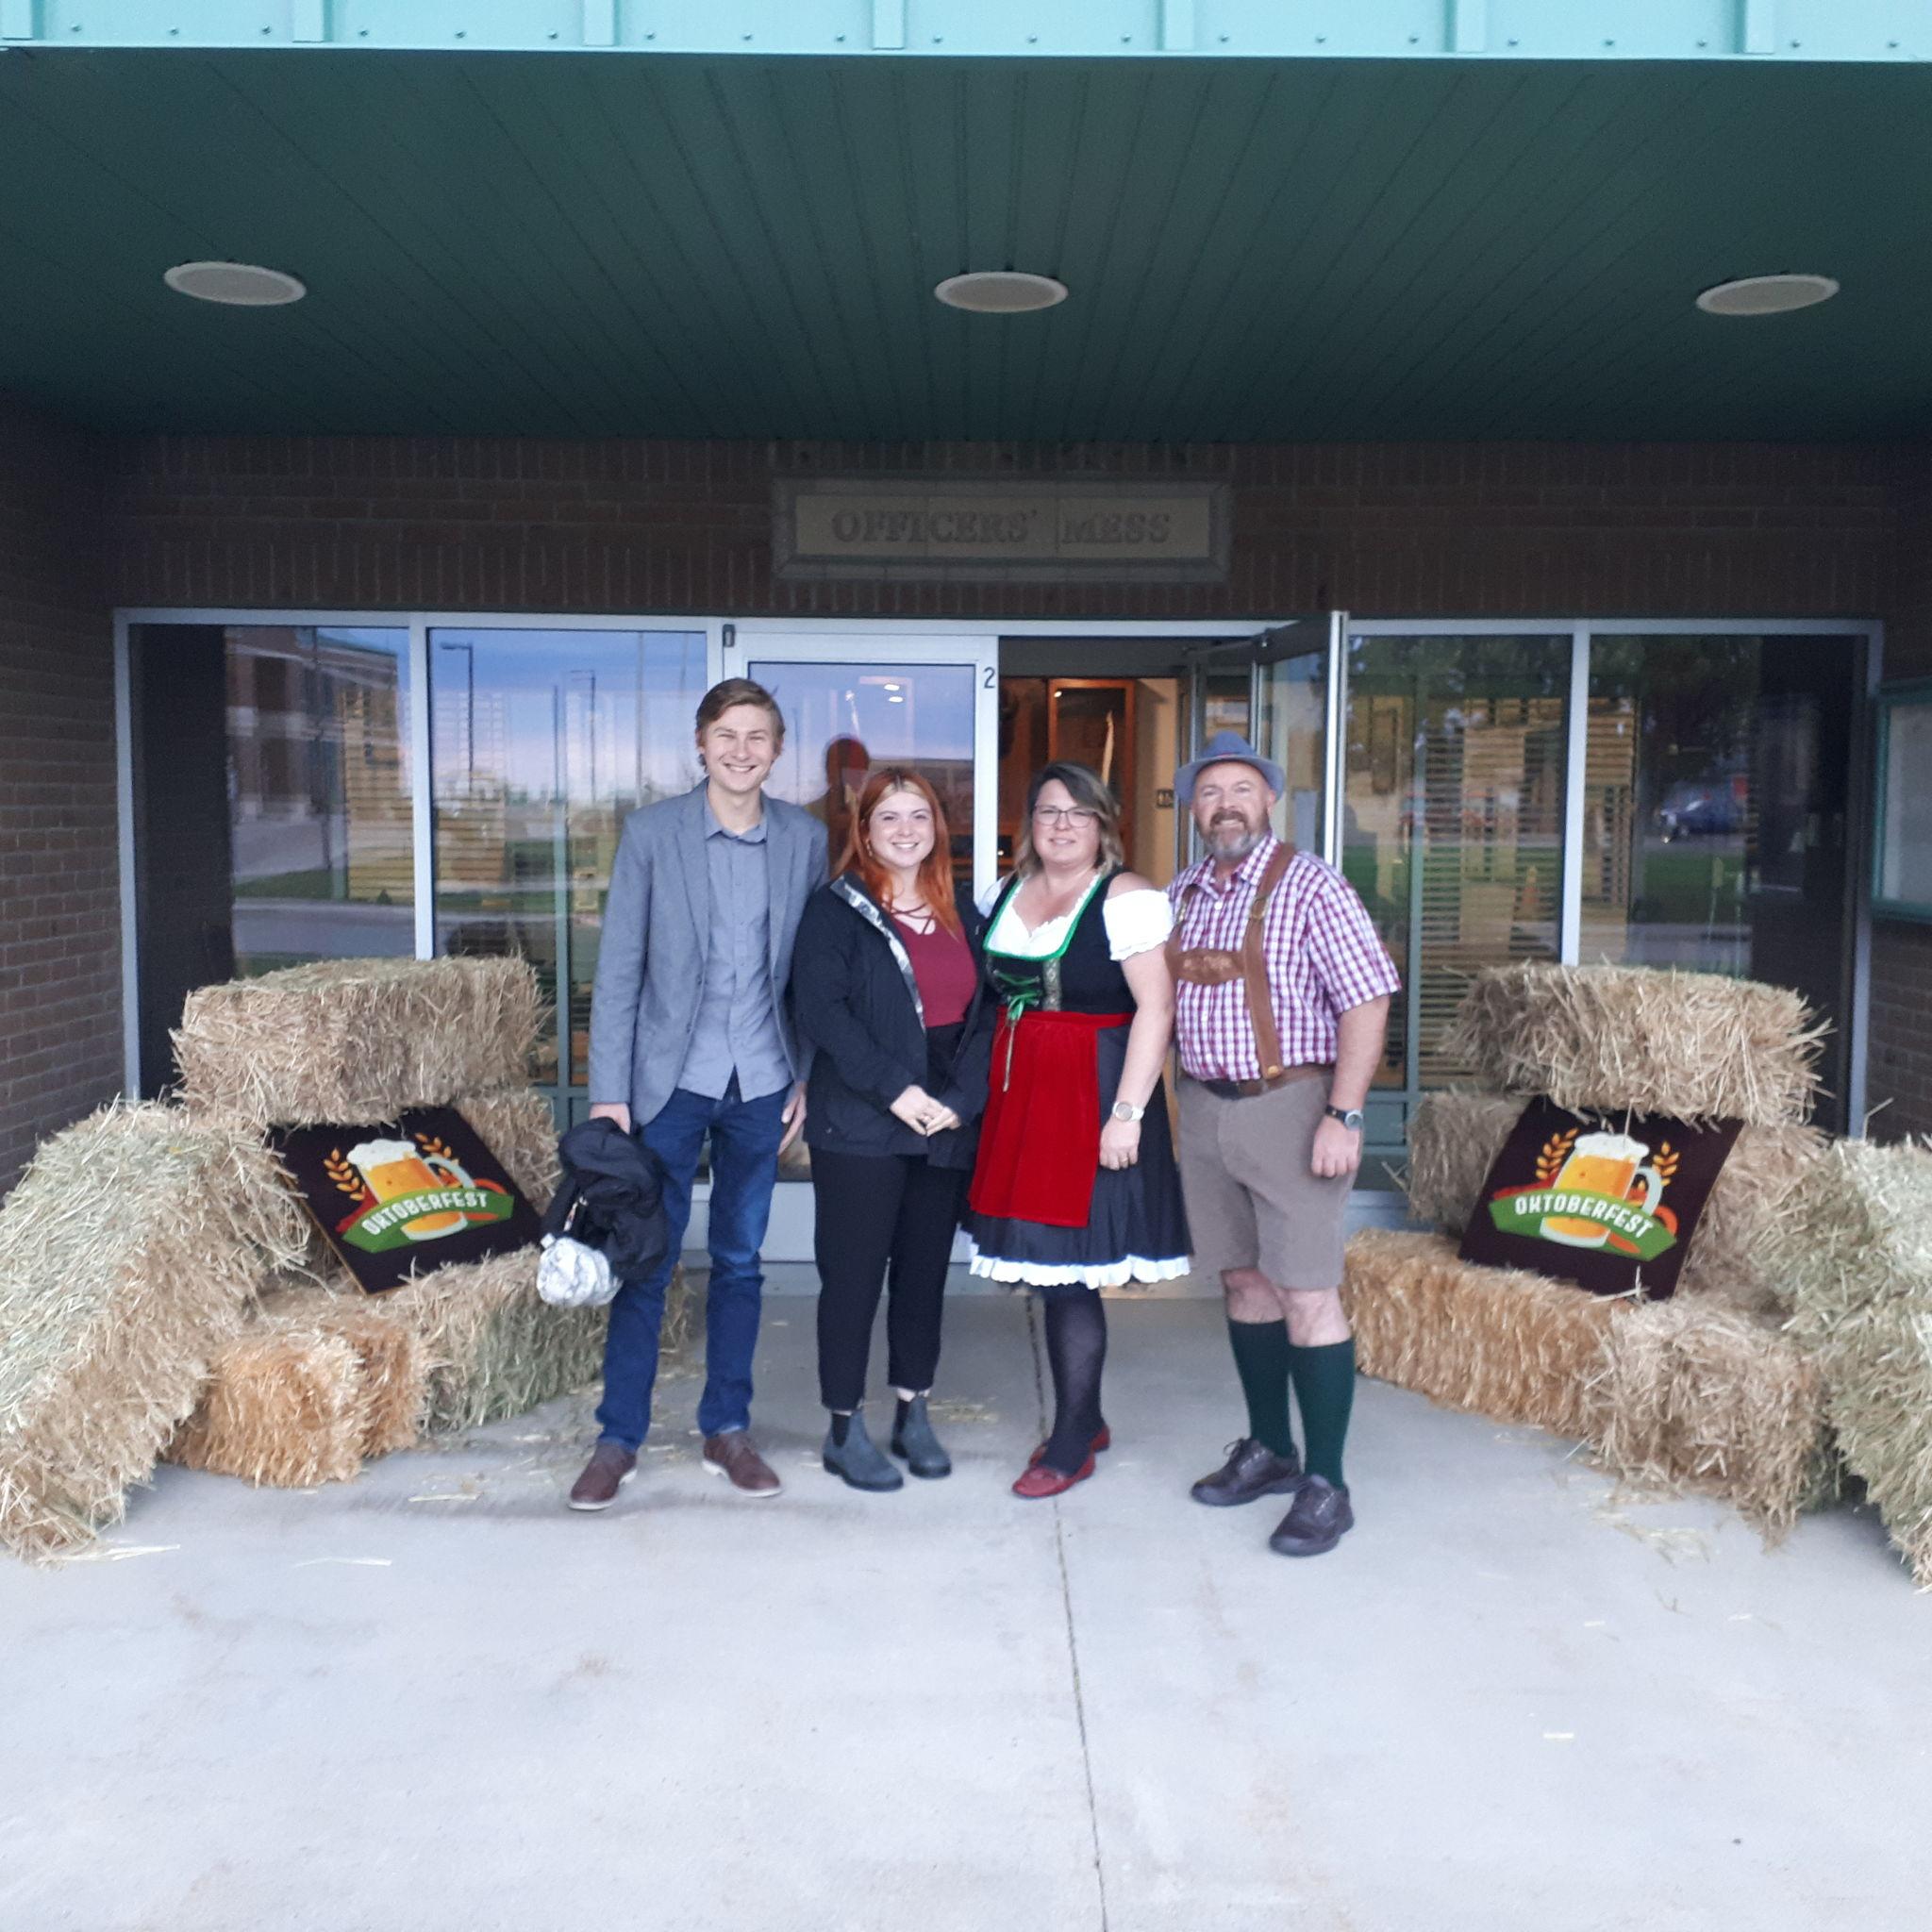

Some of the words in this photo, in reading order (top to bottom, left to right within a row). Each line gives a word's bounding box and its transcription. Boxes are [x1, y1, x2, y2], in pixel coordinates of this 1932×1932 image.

[831, 509, 1037, 544] OFFICERS'
[1061, 512, 1171, 544] MESS
[983, 667, 995, 689] 2
[361, 1191, 488, 1236] OKTOBERFEST
[1515, 1193, 1653, 1238] OKTOBERFEST
